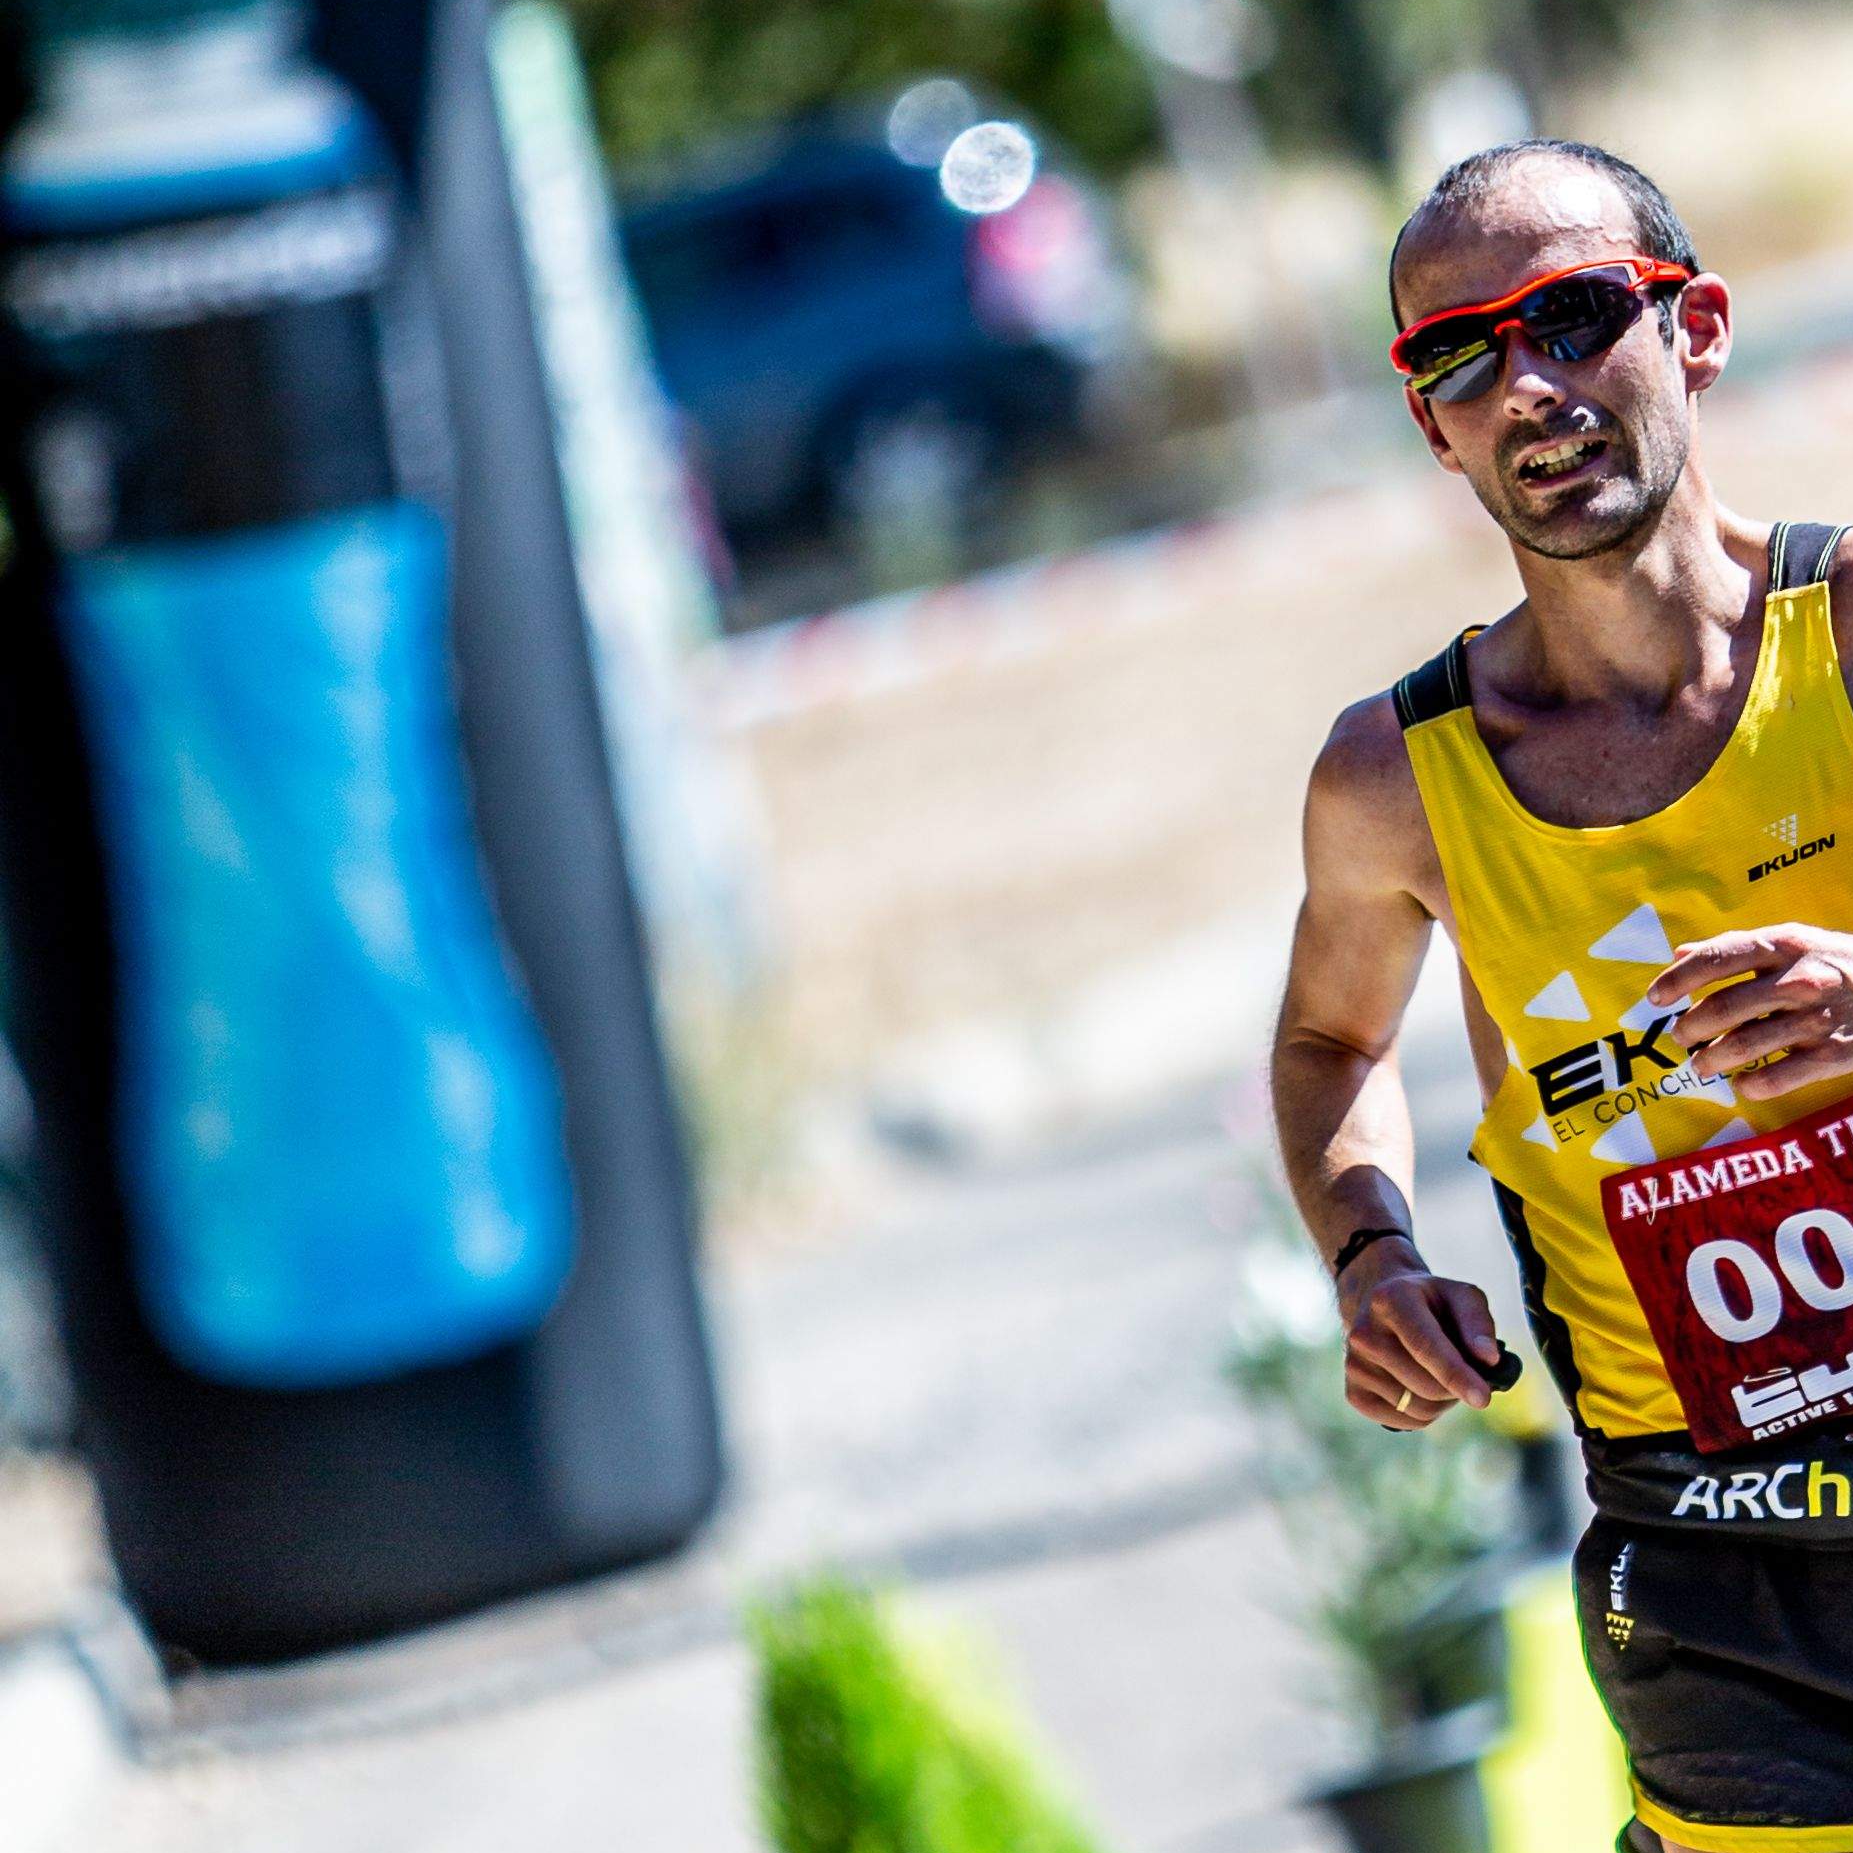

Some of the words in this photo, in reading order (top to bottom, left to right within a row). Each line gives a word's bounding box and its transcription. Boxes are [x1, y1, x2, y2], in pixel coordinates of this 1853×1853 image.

[1746, 832, 1836, 883] EKUON
[1552, 1117, 1586, 1144] EL
[1617, 1138, 1815, 1221] ALAMEDA
[1752, 1399, 1839, 1442] ACTIVE
